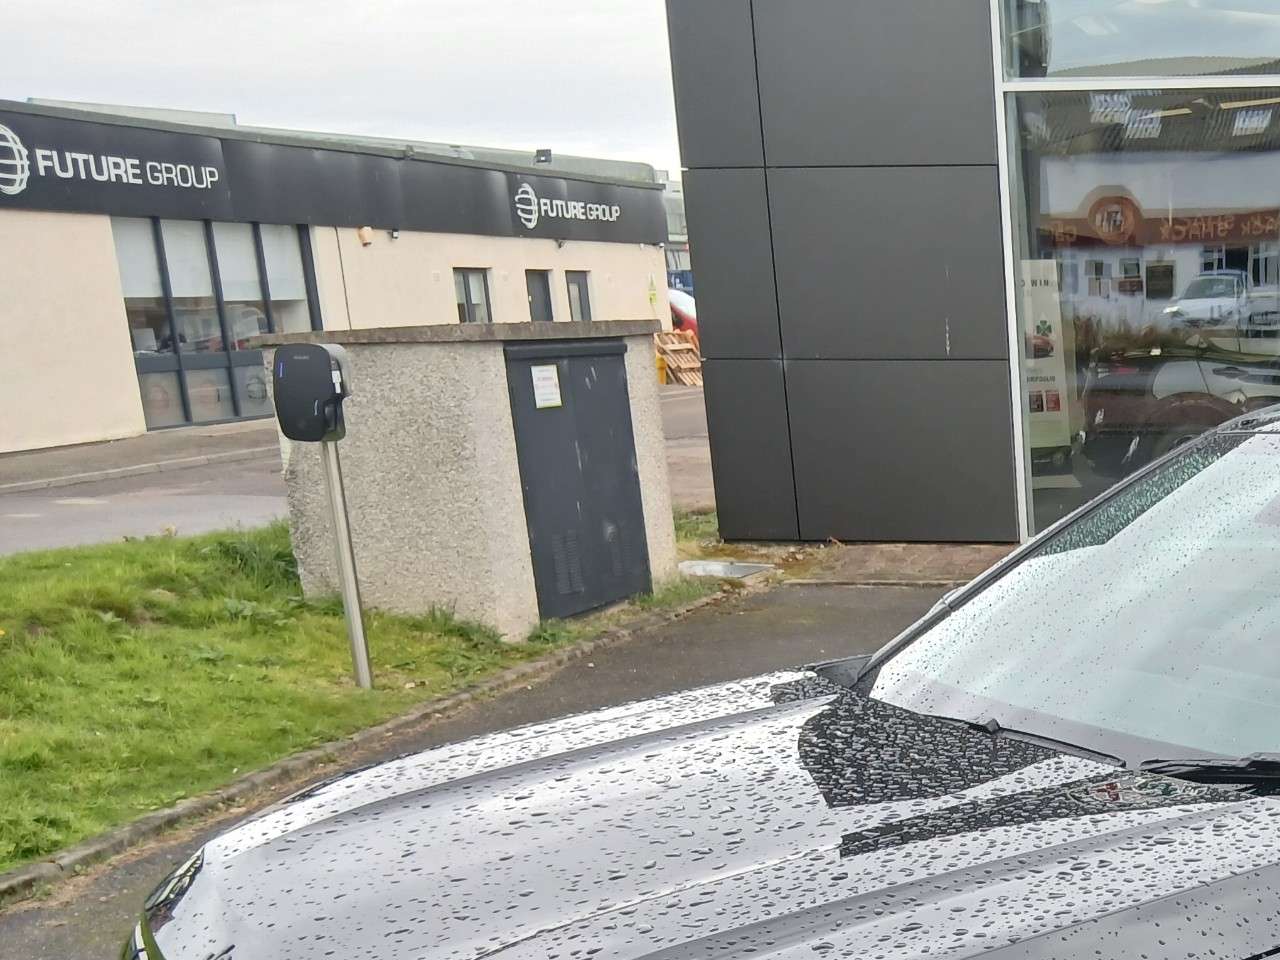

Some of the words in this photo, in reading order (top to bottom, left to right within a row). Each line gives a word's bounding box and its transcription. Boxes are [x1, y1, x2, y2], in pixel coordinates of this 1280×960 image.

[35, 148, 142, 185] FUTURE
[146, 161, 219, 189] GROUP
[540, 198, 587, 220] FUTURE
[586, 203, 620, 222] GROUP
